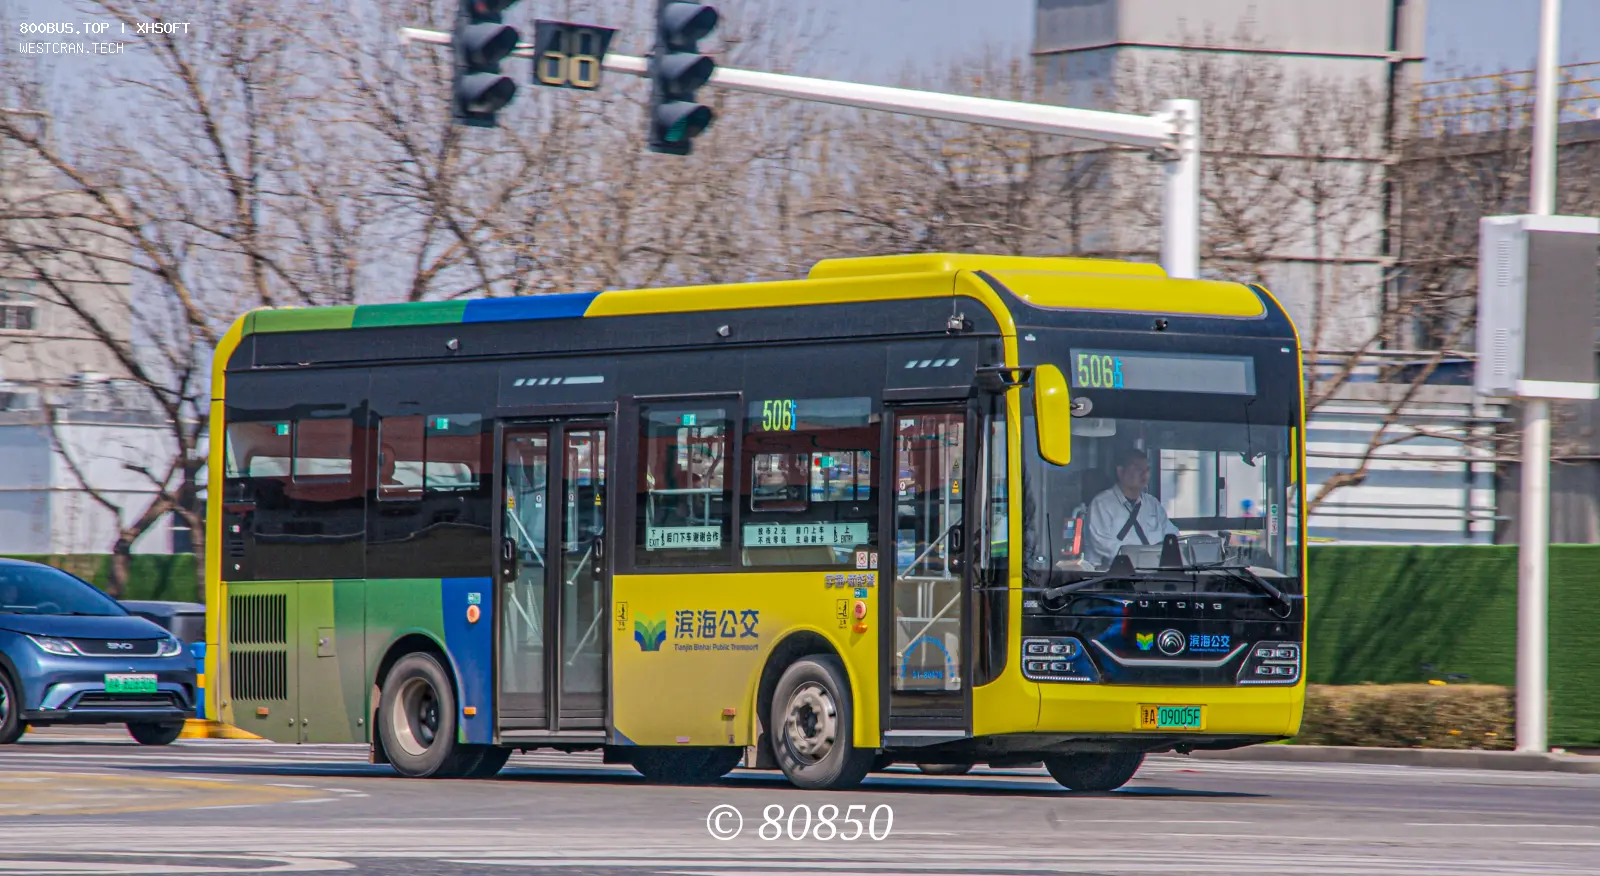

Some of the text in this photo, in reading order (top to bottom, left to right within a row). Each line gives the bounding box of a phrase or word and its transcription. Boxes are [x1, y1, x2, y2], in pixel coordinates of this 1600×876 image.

[1078, 354, 1113, 388] 506
[762, 399, 791, 431] 506
[1120, 599, 1222, 610] YUTONG
[674, 609, 760, 639] 滨海公交
[674, 643, 759, 652] Tianjin Binhai Public Transport
[1189, 634, 1231, 648] 滨海公交
